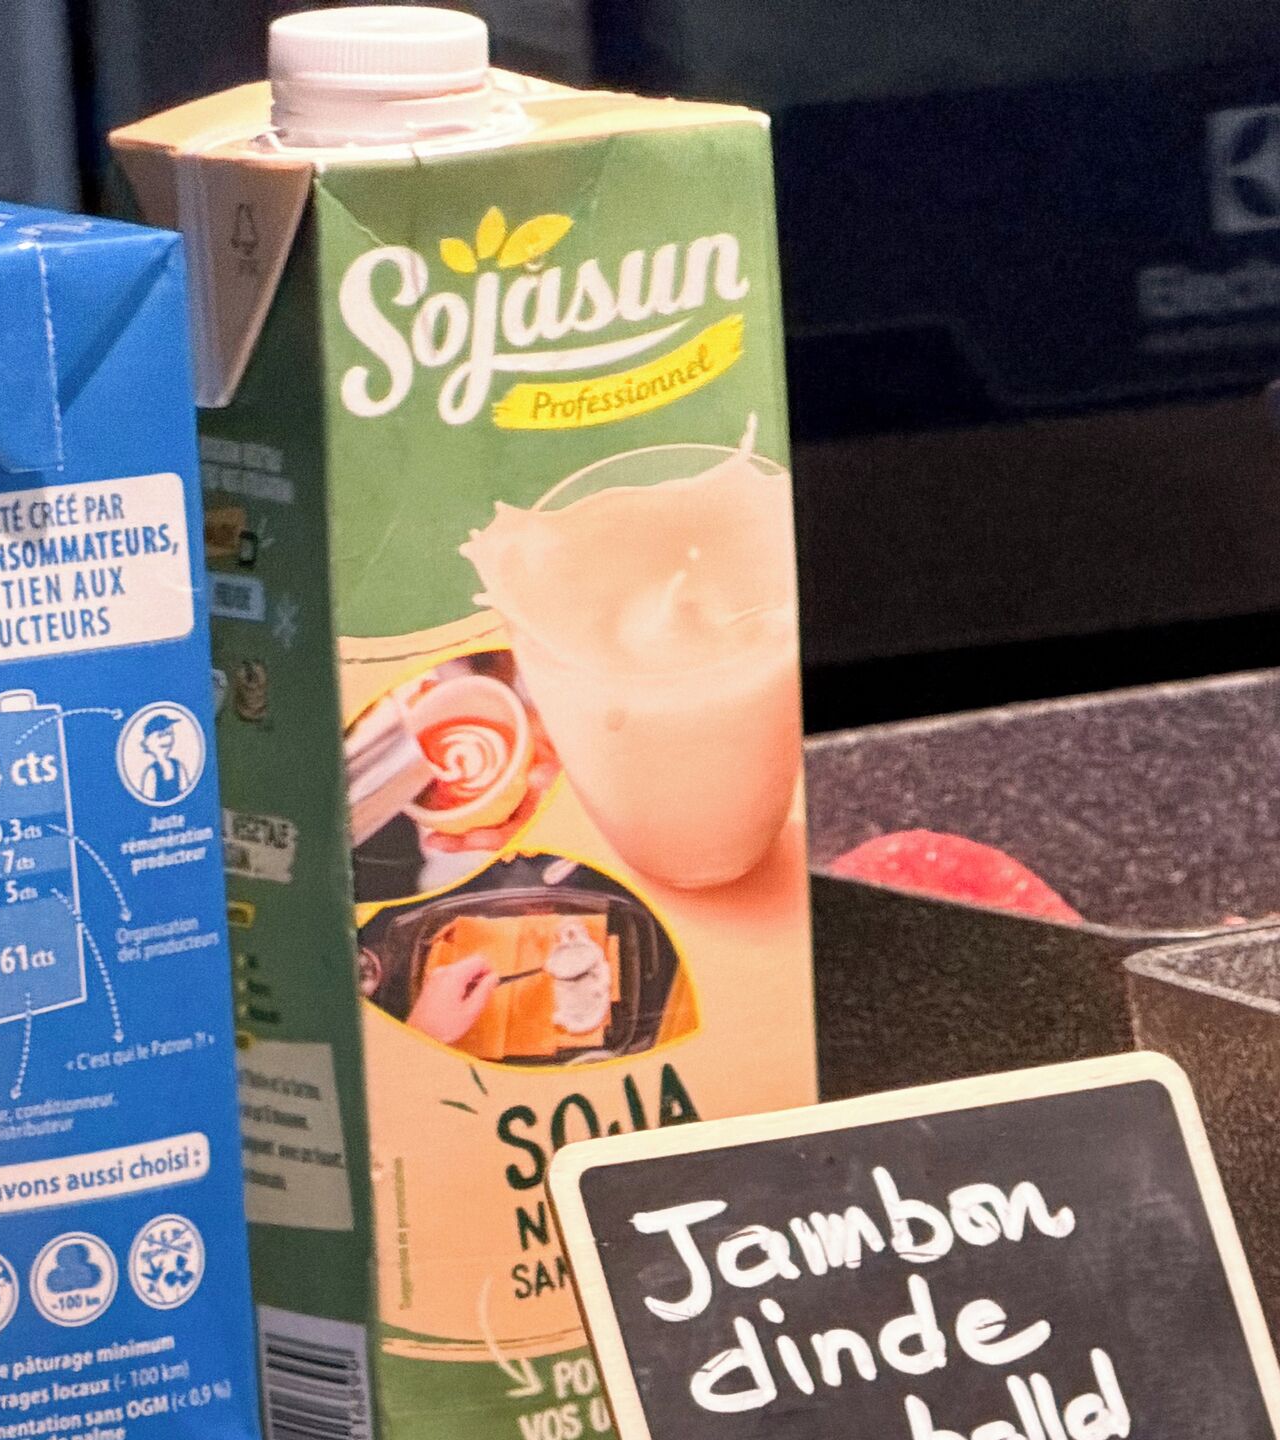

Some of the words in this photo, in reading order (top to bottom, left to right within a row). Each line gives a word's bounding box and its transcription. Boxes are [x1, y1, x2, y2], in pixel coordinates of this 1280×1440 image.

[338, 233, 750, 427] Sojasun
[528, 342, 713, 421] Professionnel
[28, 493, 80, 531] CRÉÉ
[84, 491, 126, 524] PAR
[73, 565, 126, 602] AUX
[10, 751, 58, 787] cts
[2, 849, 15, 876] 7
[5, 880, 18, 904] 5
[0, 943, 30, 976] 61
[496, 1063, 704, 1191] SOJA
[66, 1160, 125, 1191] aussi
[128, 1147, 189, 1181] choisi
[515, 1202, 551, 1251] N
[630, 1166, 1075, 1322] Jambon
[511, 1255, 573, 1299] SAN
[12, 1352, 94, 1381] pâturage
[96, 1335, 176, 1363] minimum
[690, 1274, 1051, 1413] dinde
[53, 1377, 111, 1400] locaux
[552, 1357, 597, 1399] PO
[84, 1406, 125, 1427] sans
[126, 1394, 170, 1420] OGM
